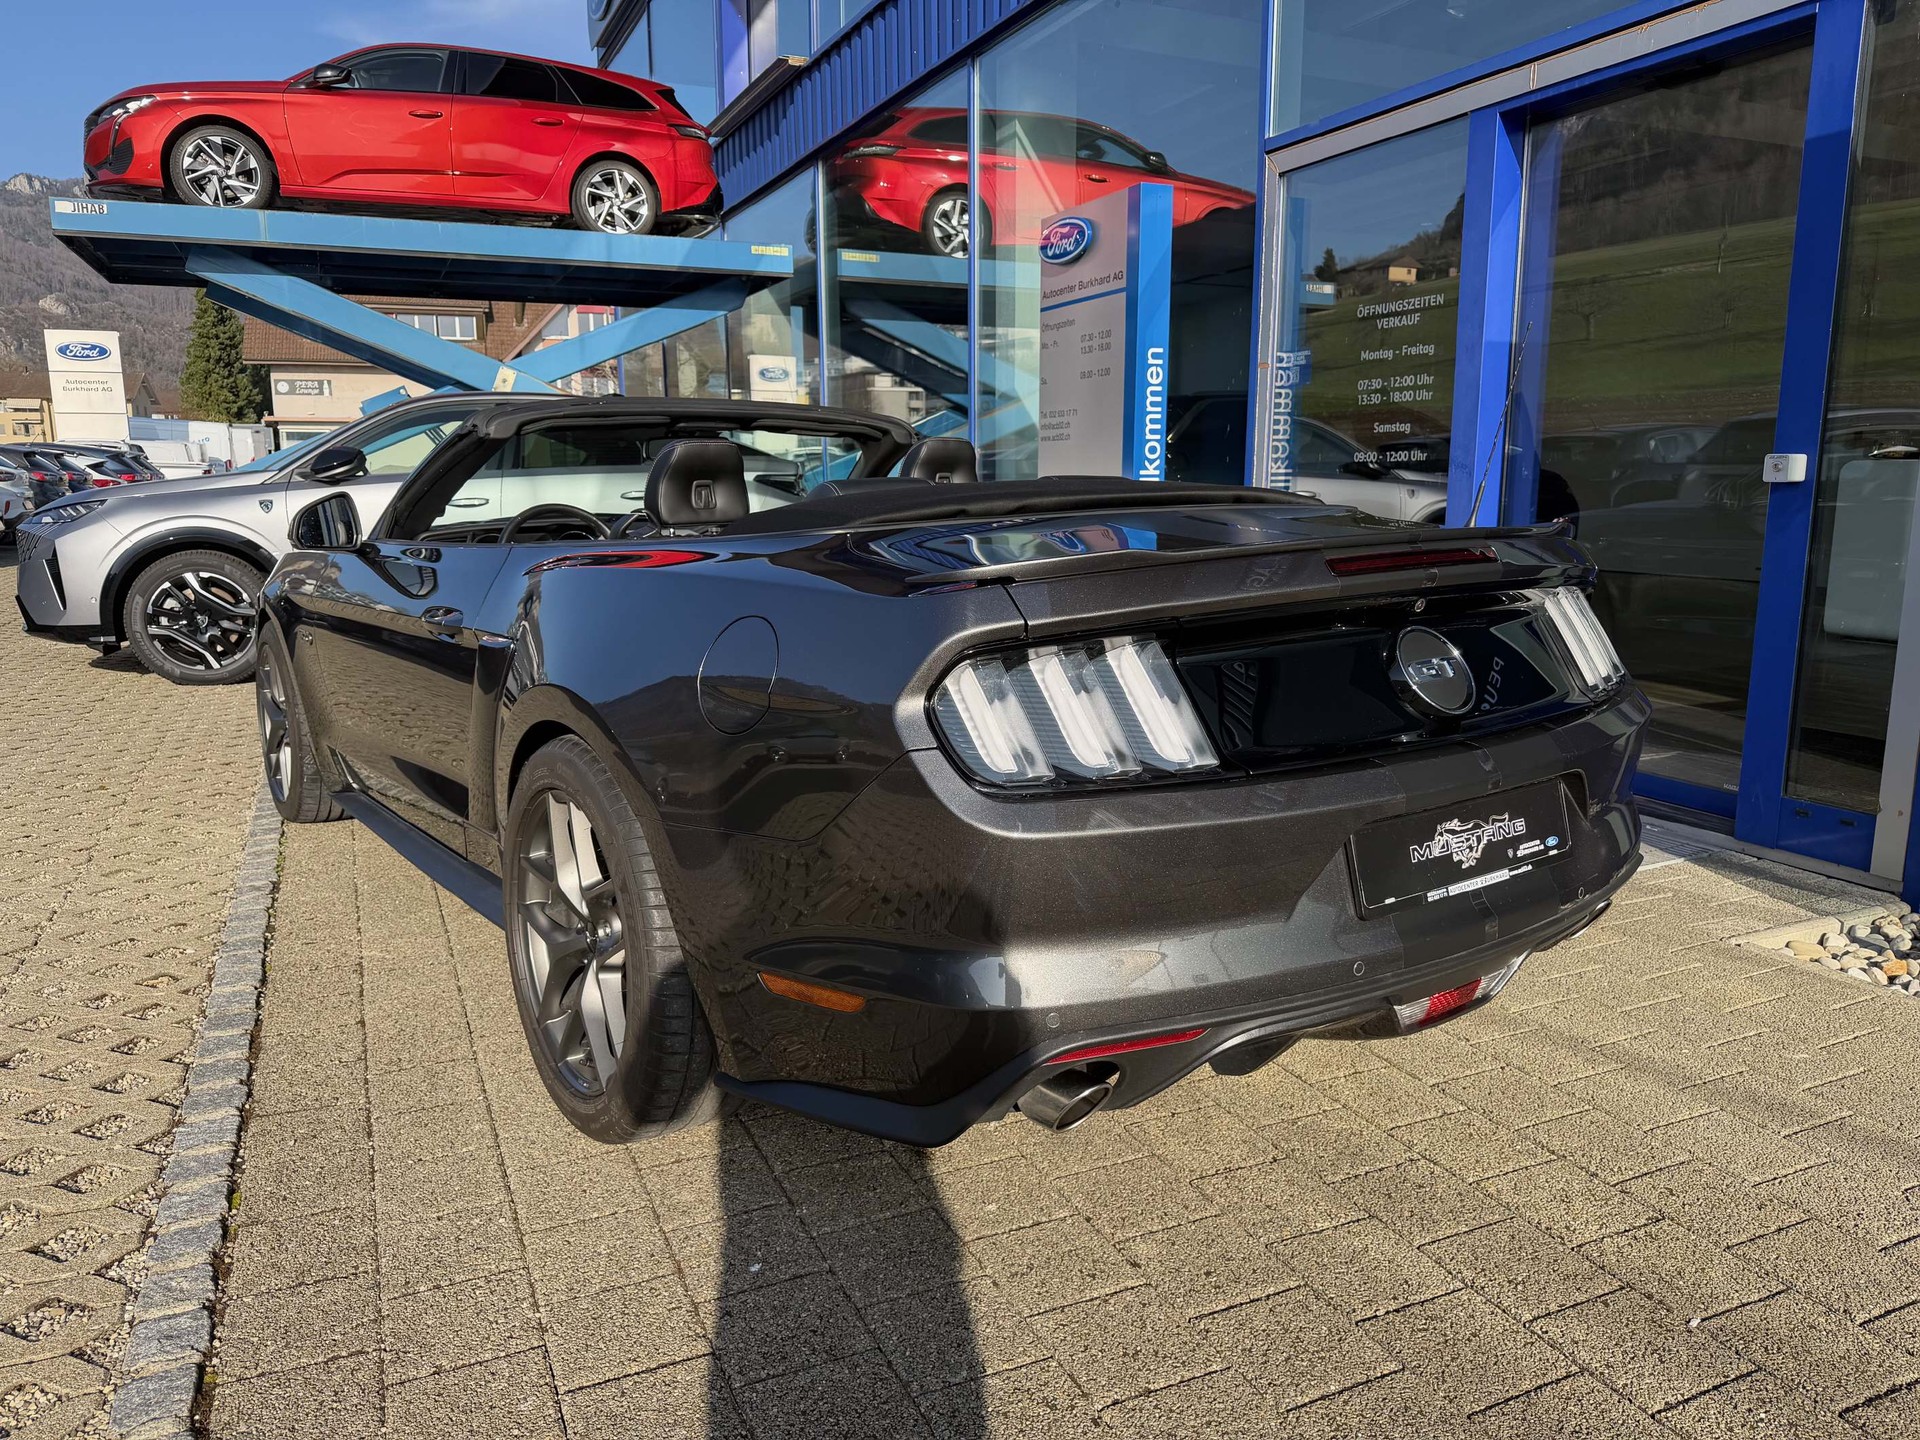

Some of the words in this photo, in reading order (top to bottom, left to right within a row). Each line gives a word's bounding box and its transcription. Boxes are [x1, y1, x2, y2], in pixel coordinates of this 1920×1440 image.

[71, 202, 105, 215] JIHAB
[1047, 225, 1078, 257] Ford
[1042, 283, 1077, 300] Autocenter
[1078, 273, 1111, 290] Burkhard
[1112, 270, 1124, 282] AG
[1357, 293, 1445, 318] ÖFFNUNGSZEITEN
[1376, 313, 1421, 329] VERKAUF
[1098, 329, 1112, 340] 12.00
[66, 343, 100, 357] Ford
[1360, 349, 1393, 361] Montag
[1402, 343, 1435, 356] Freitag
[1357, 378, 1382, 390] 07:30
[1390, 375, 1414, 387] 12:00
[1417, 373, 1434, 385] Uhr
[1358, 393, 1381, 405] 13:30
[1390, 390, 1414, 402] 18:00
[1416, 389, 1433, 401] Uhr
[1373, 422, 1411, 434] Samstag
[1353, 451, 1377, 463] 09:00
[1386, 450, 1409, 462] 12:00
[1410, 449, 1428, 461] Uhr
[1408, 658, 1455, 681] GT
[1409, 817, 1526, 863] MUSTANG
[1449, 880, 1479, 894] AUTOCENTER
